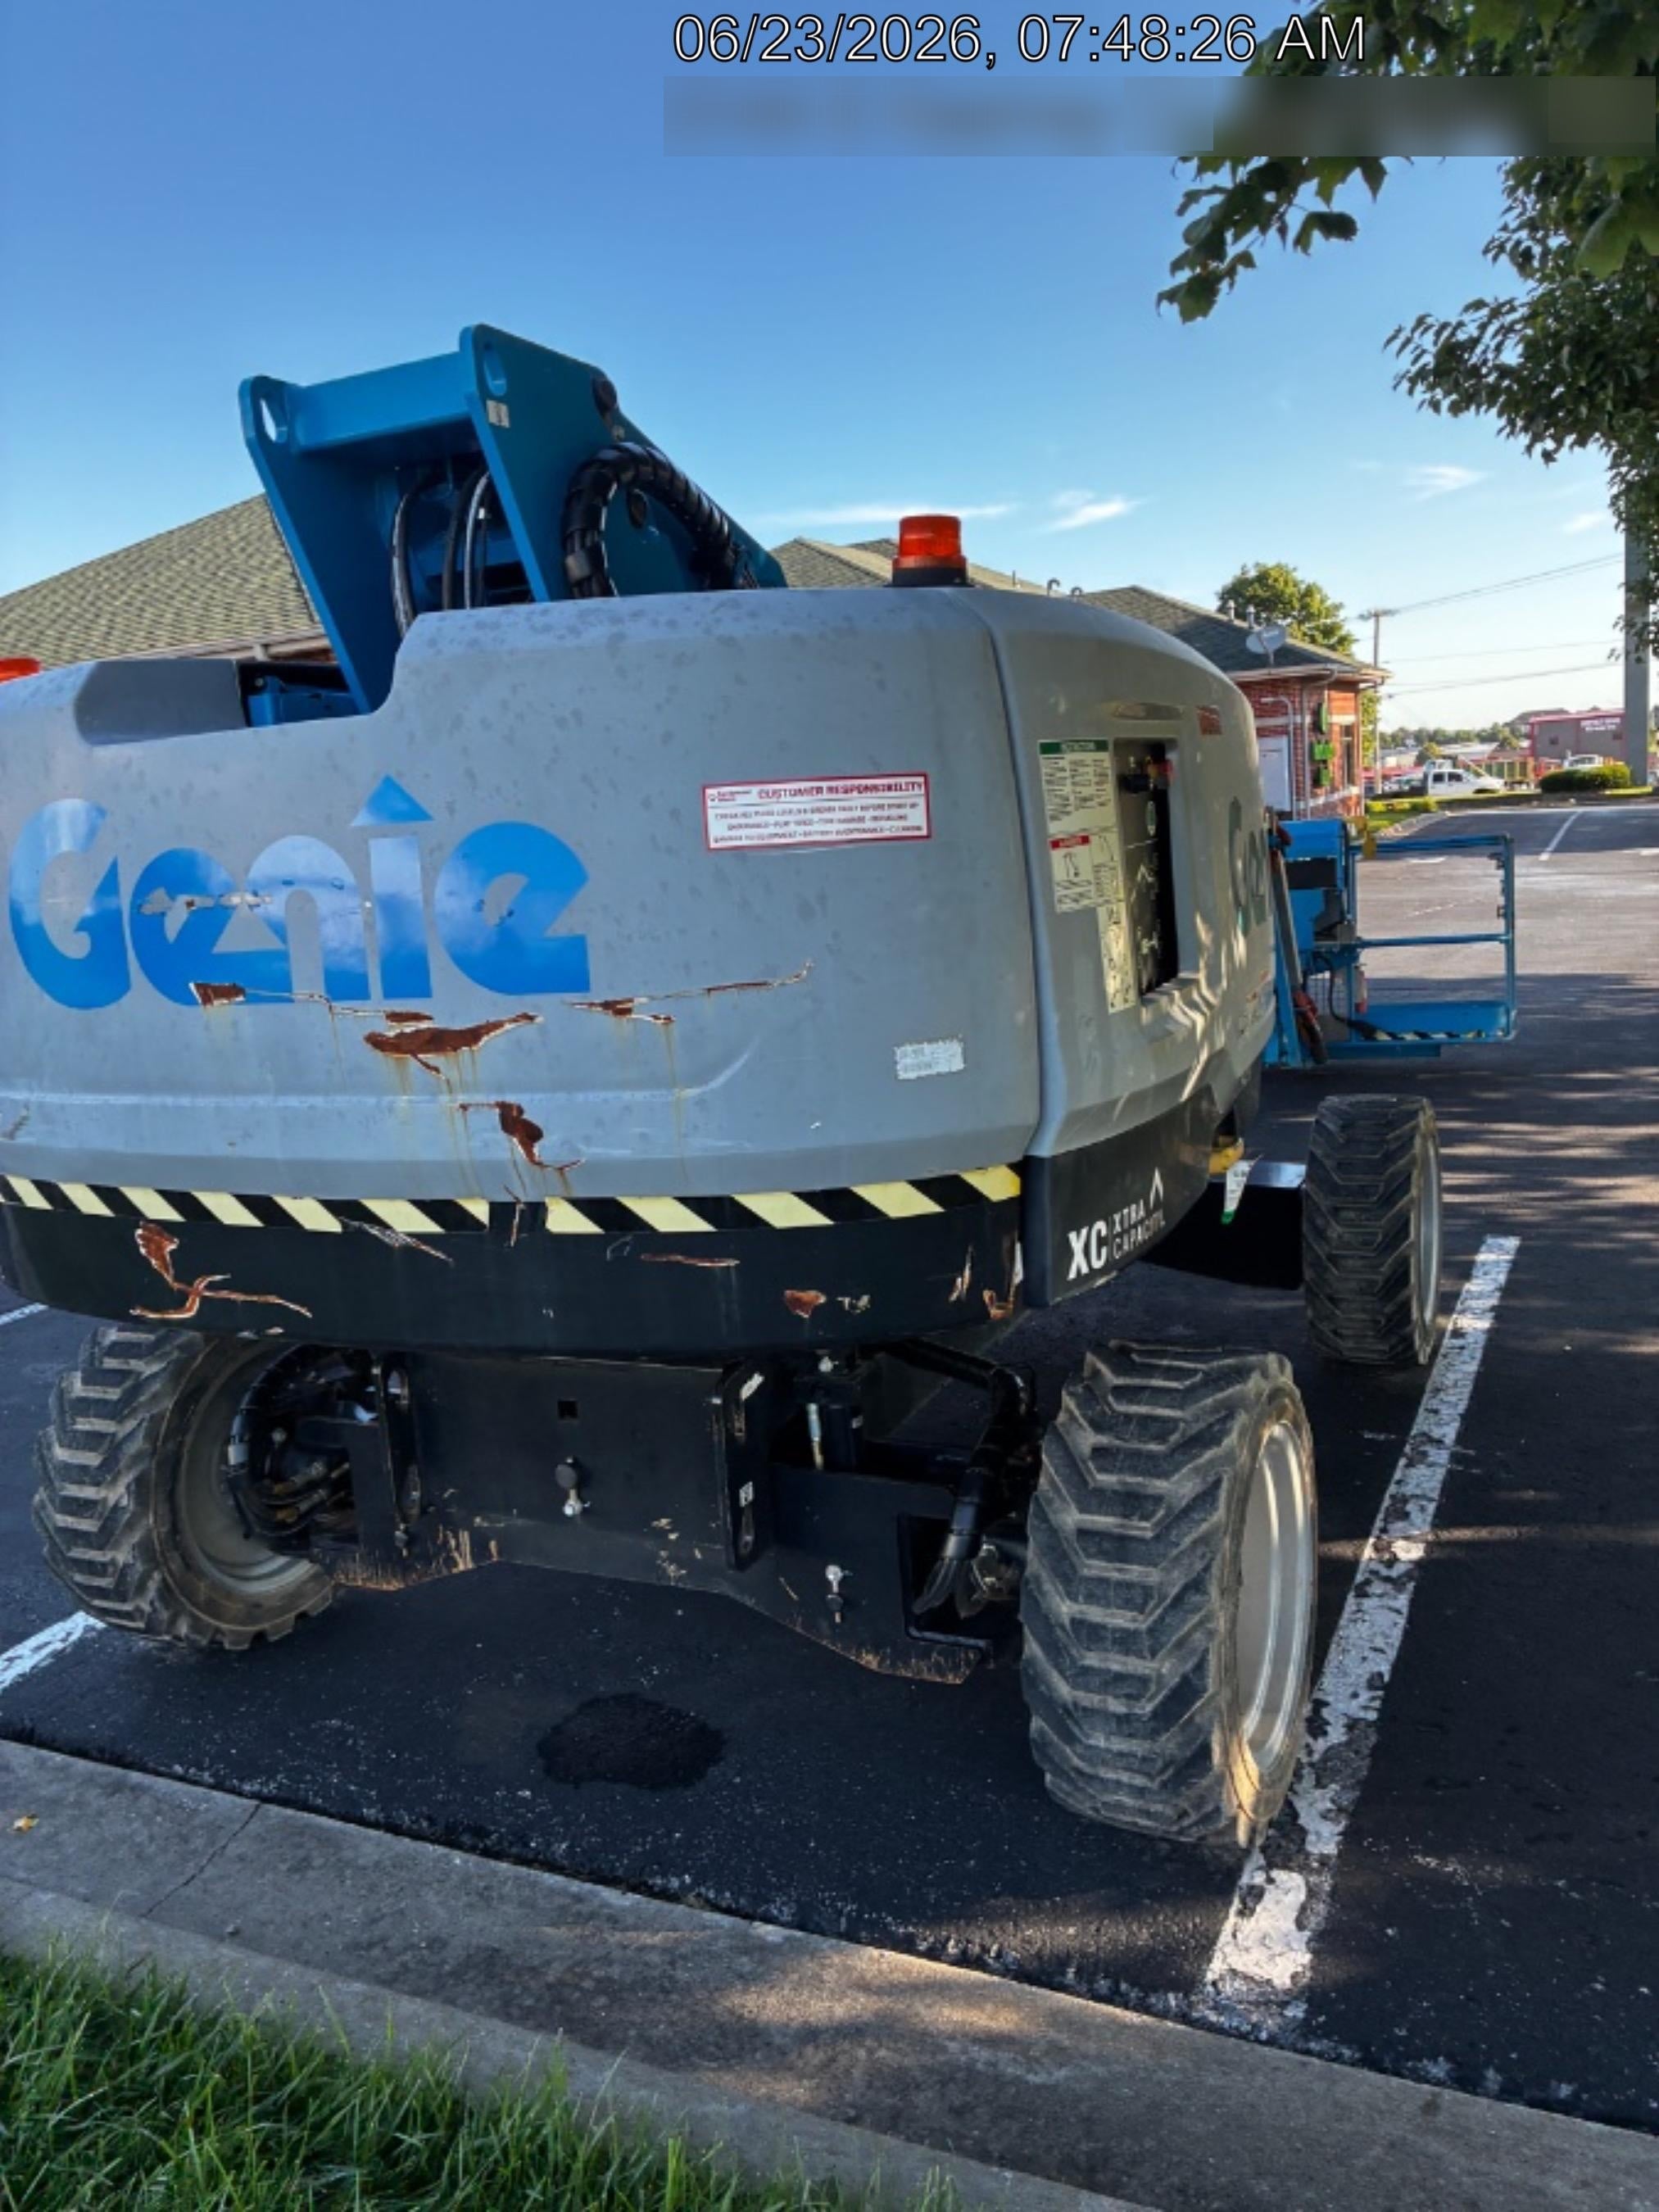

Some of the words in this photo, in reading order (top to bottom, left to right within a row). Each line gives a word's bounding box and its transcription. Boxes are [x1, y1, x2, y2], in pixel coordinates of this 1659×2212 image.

[757, 785, 824, 800] CUSTOMER
[824, 781, 923, 796] RESPONSIBILITY
[9, 774, 592, 1010] Genie
[1113, 1198, 1146, 1235] XTRA
[1067, 1220, 1107, 1281] XC
